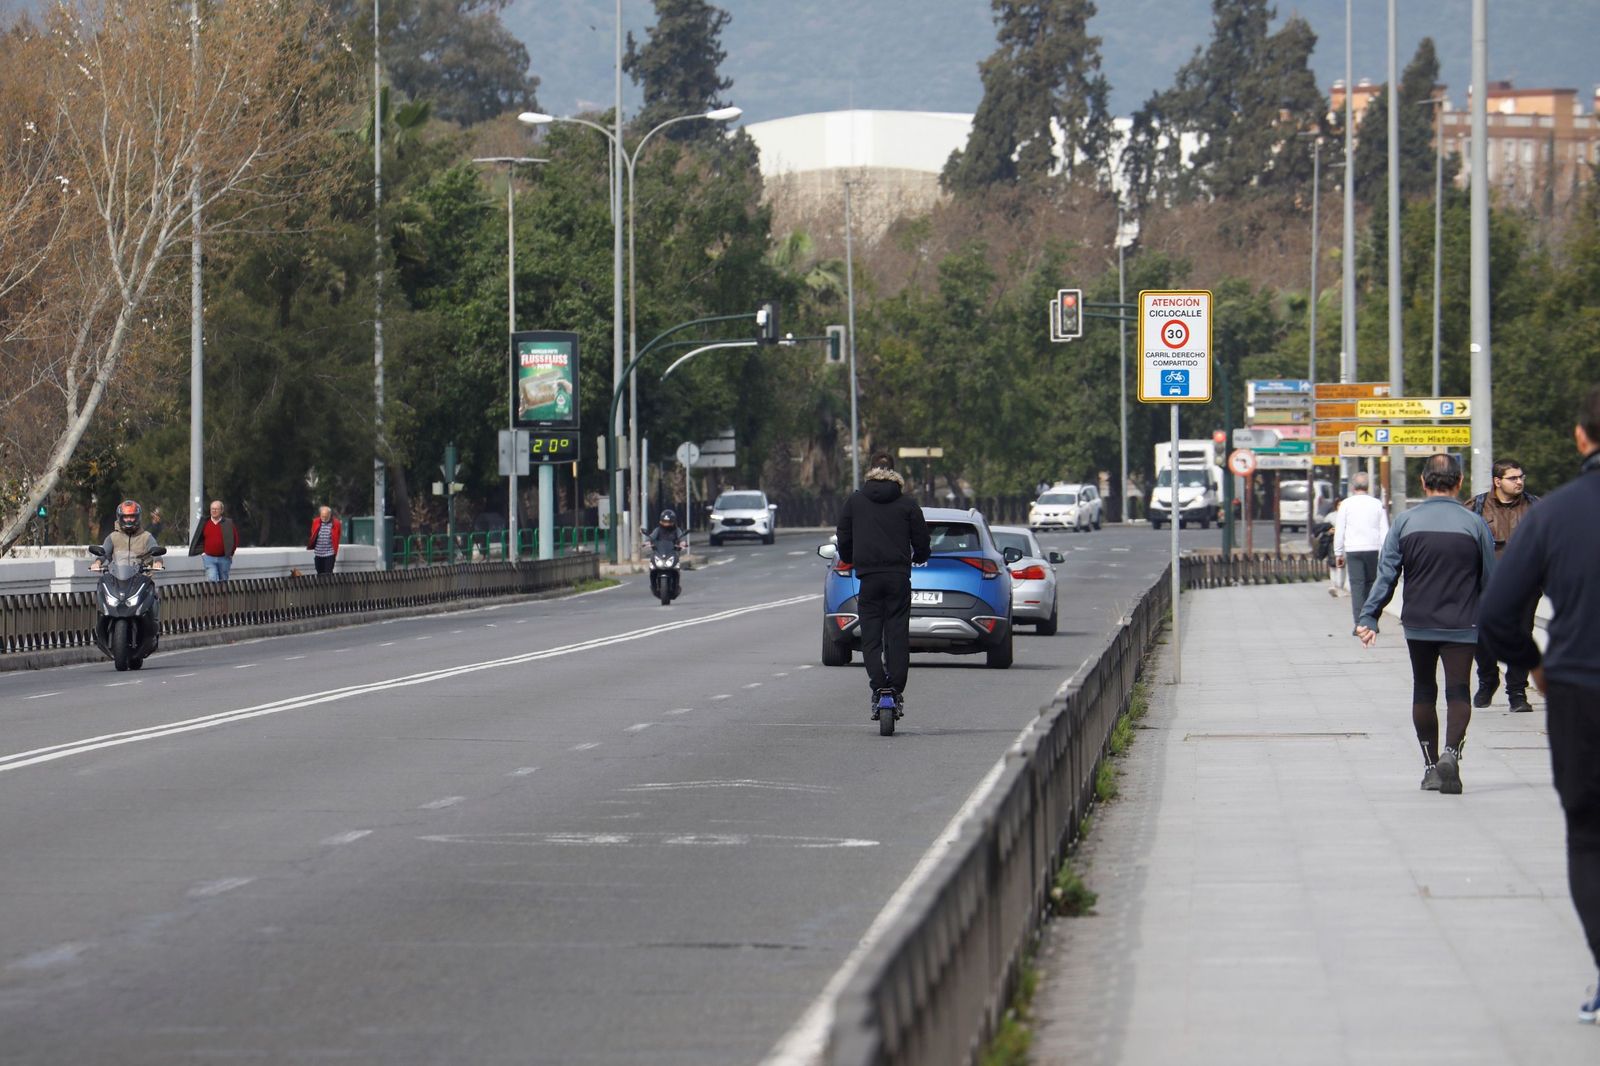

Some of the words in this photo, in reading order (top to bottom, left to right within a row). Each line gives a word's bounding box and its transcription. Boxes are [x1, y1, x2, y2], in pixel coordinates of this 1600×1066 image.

[1151, 297, 1200, 306] ATENCIÓN
[1167, 329, 1183, 339] 30
[1392, 435, 1424, 443] Centro
